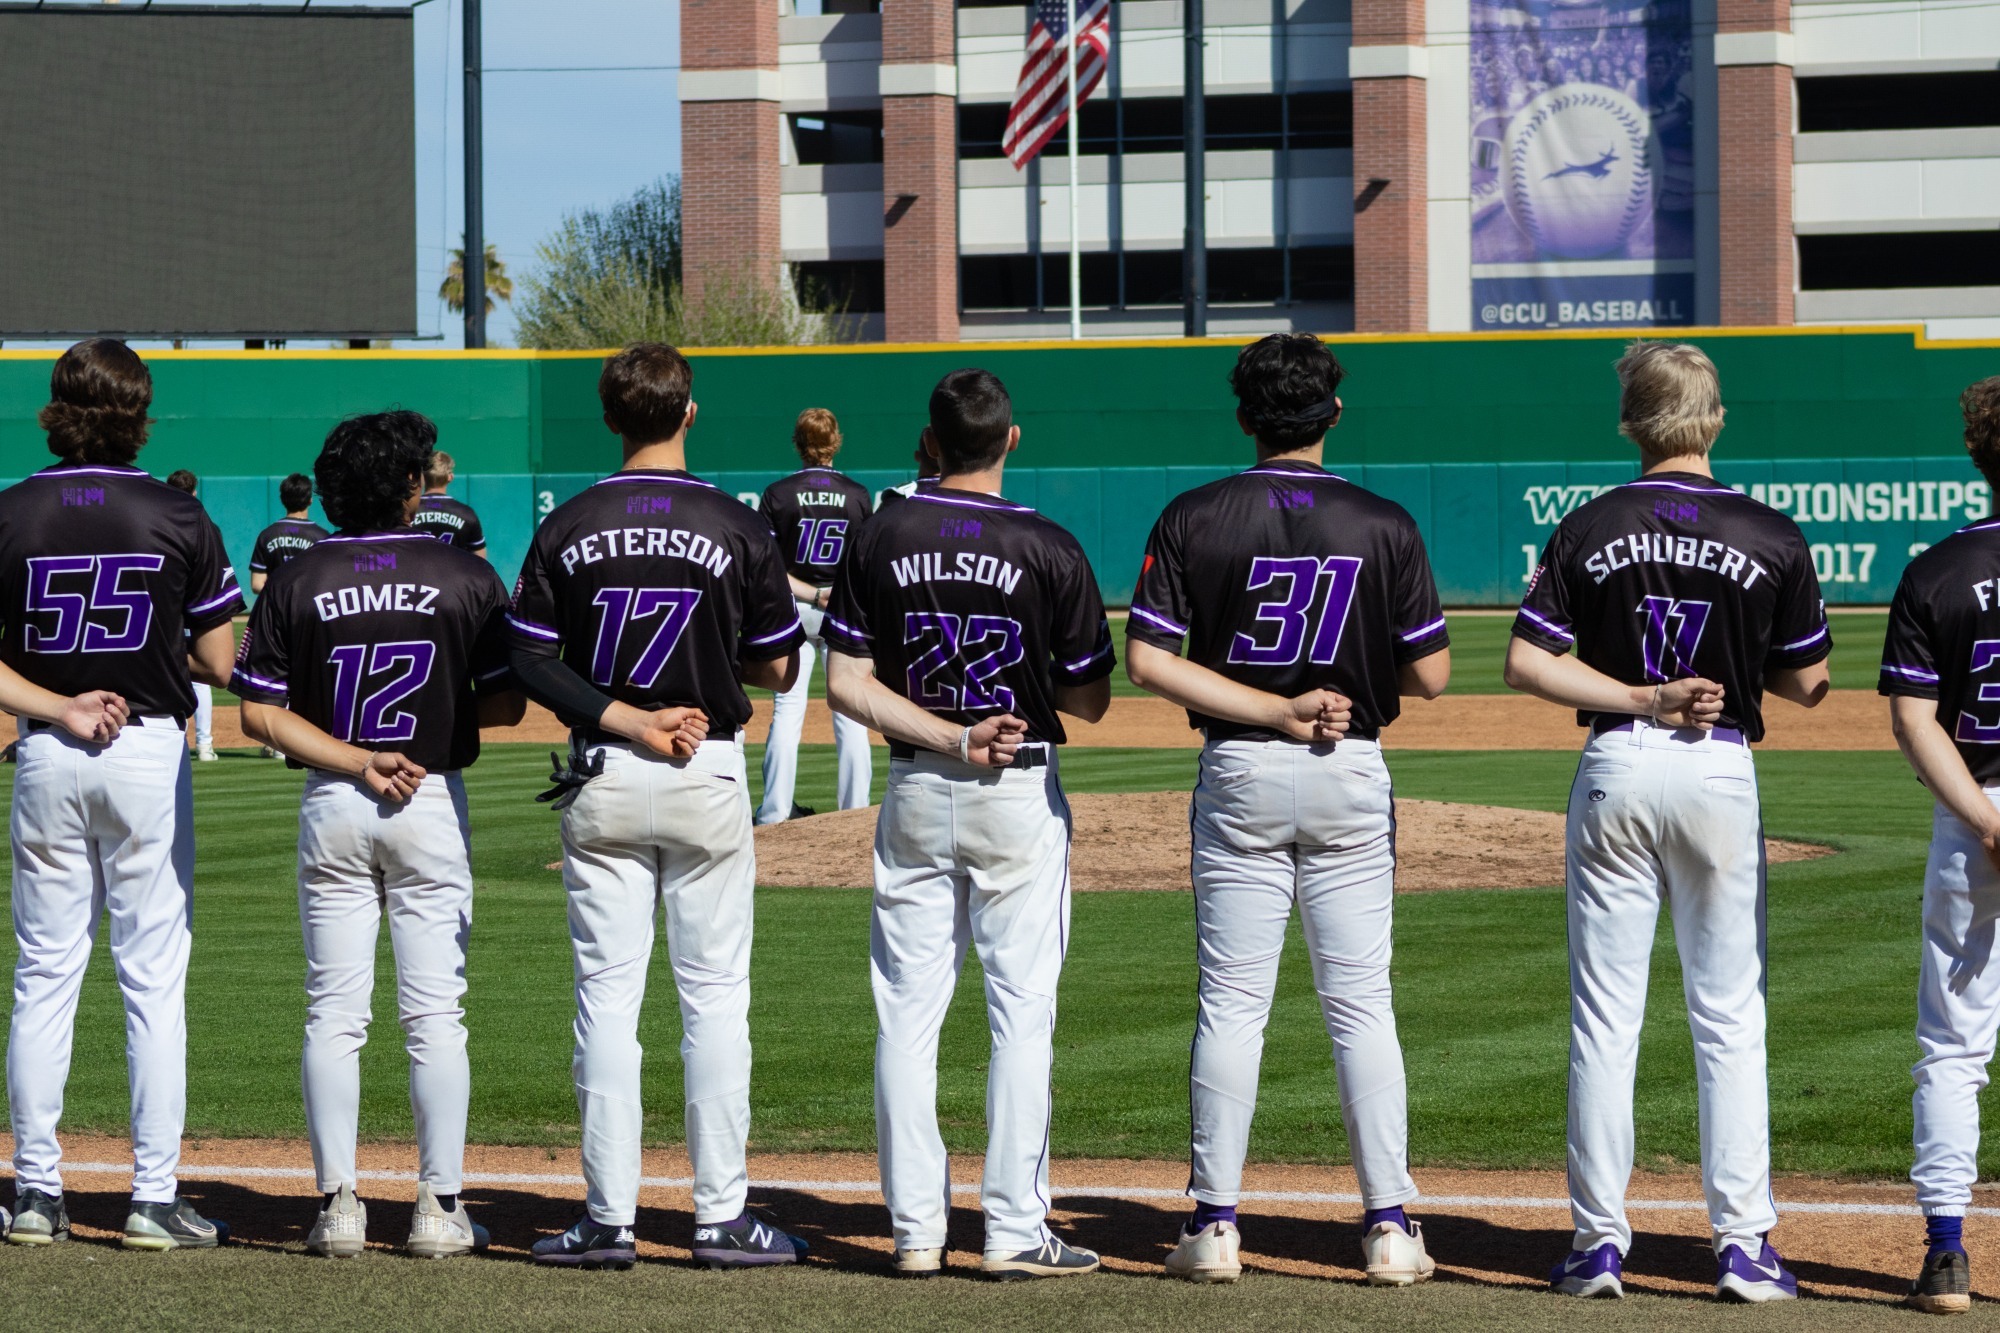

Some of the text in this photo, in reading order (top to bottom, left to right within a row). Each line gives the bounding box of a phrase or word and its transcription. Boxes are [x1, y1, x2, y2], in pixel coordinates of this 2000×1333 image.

[1481, 300, 1684, 328] @GCU_BASEBALL
[410, 511, 466, 530] ETERSON
[797, 491, 847, 508] KLEIN
[1523, 484, 1618, 525] WA
[266, 536, 314, 553] STOCKIN
[561, 527, 732, 578] PETERSON
[795, 517, 850, 566] 16
[1584, 533, 1768, 590] SCHUBERT
[1809, 543, 1877, 583] 017
[891, 552, 1022, 596] WILSON
[25, 553, 165, 654] 55
[313, 583, 441, 622] GOMEZ
[1227, 556, 1364, 666] 31
[592, 587, 703, 689] 17
[904, 612, 1024, 712] 22
[1635, 594, 1712, 683] 11
[327, 640, 436, 743] 12
